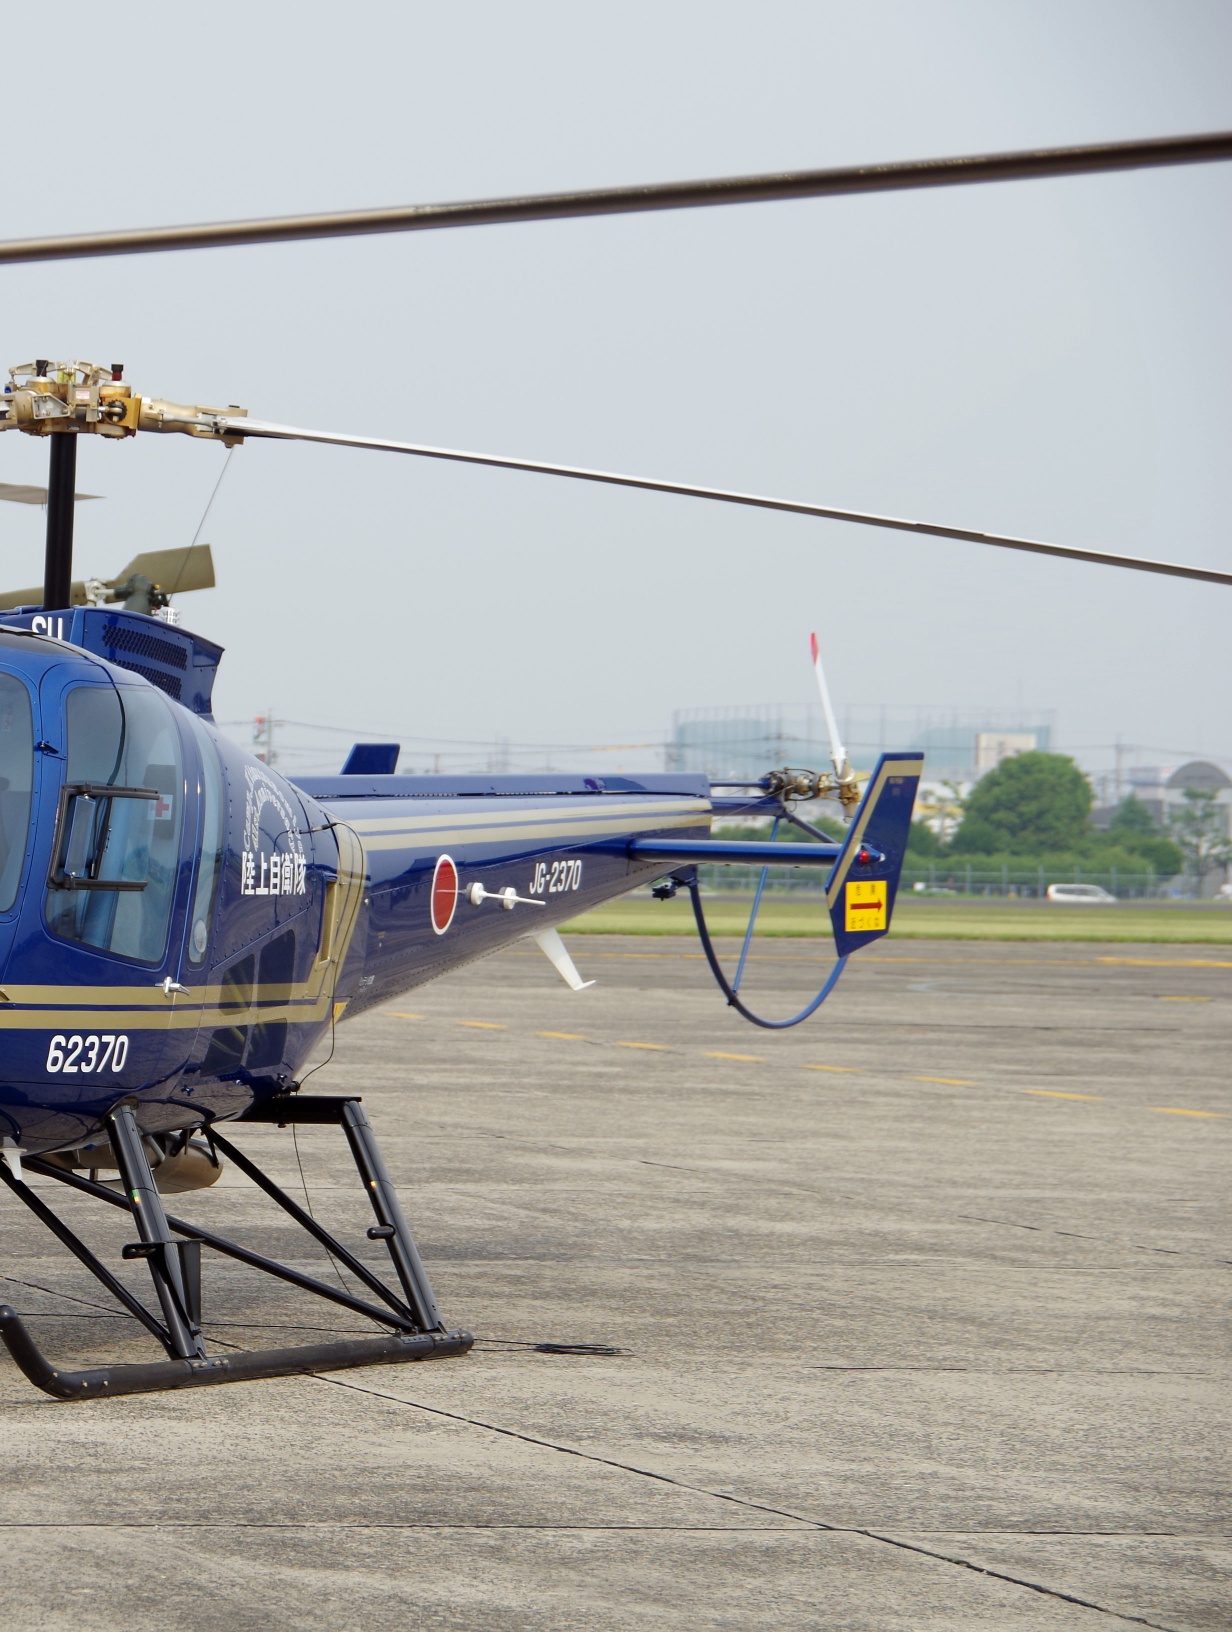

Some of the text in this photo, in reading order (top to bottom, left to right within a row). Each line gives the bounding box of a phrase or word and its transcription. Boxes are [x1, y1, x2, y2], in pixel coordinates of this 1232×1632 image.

[241, 851, 306, 895] 陸上自衛隊
[529, 859, 582, 894] JG-2370
[46, 1035, 129, 1074] 62370
